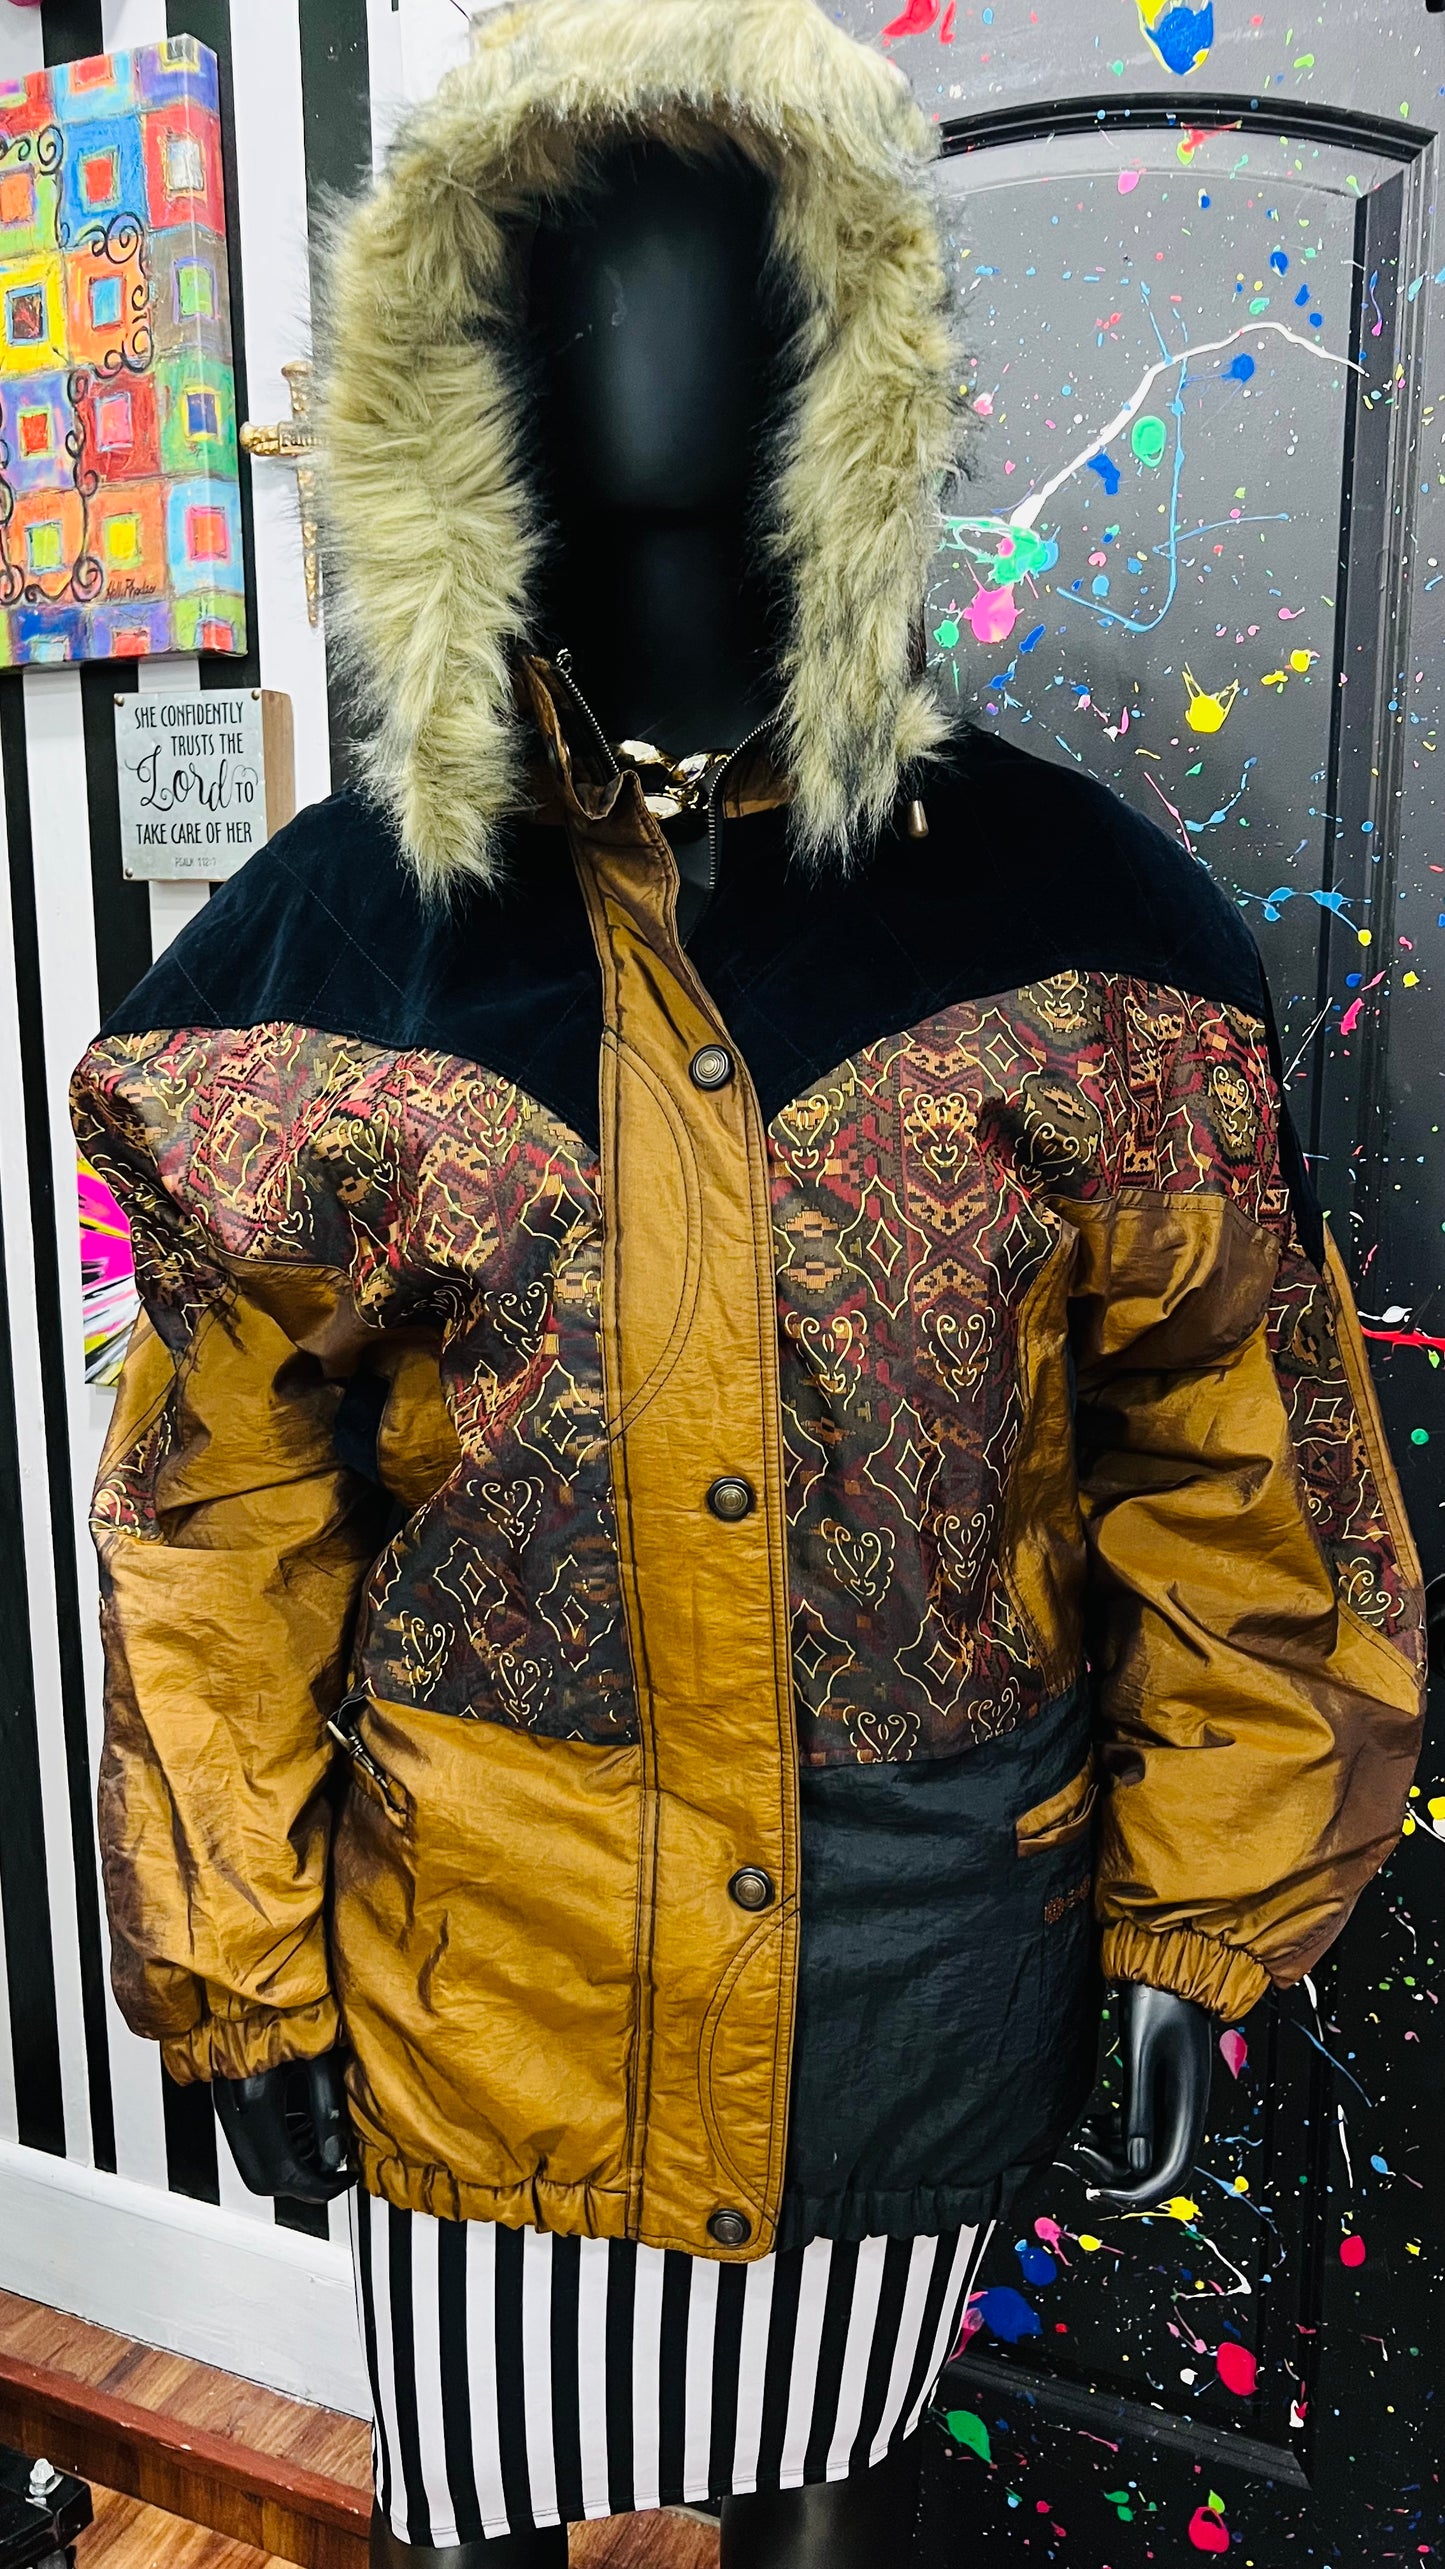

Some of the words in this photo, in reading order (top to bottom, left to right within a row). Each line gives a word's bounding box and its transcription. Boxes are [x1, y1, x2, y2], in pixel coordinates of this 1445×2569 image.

[135, 706, 157, 729] SHE
[160, 701, 244, 726] CONFIDENTLY
[171, 733, 215, 756] TRUSTS
[219, 732, 244, 754] THE
[124, 744, 259, 812] Lord
[235, 781, 254, 803] TO
[136, 823, 167, 845] TAKE
[171, 823, 201, 844] CARE
[206, 823, 222, 844] OF
[226, 821, 252, 844] HER
